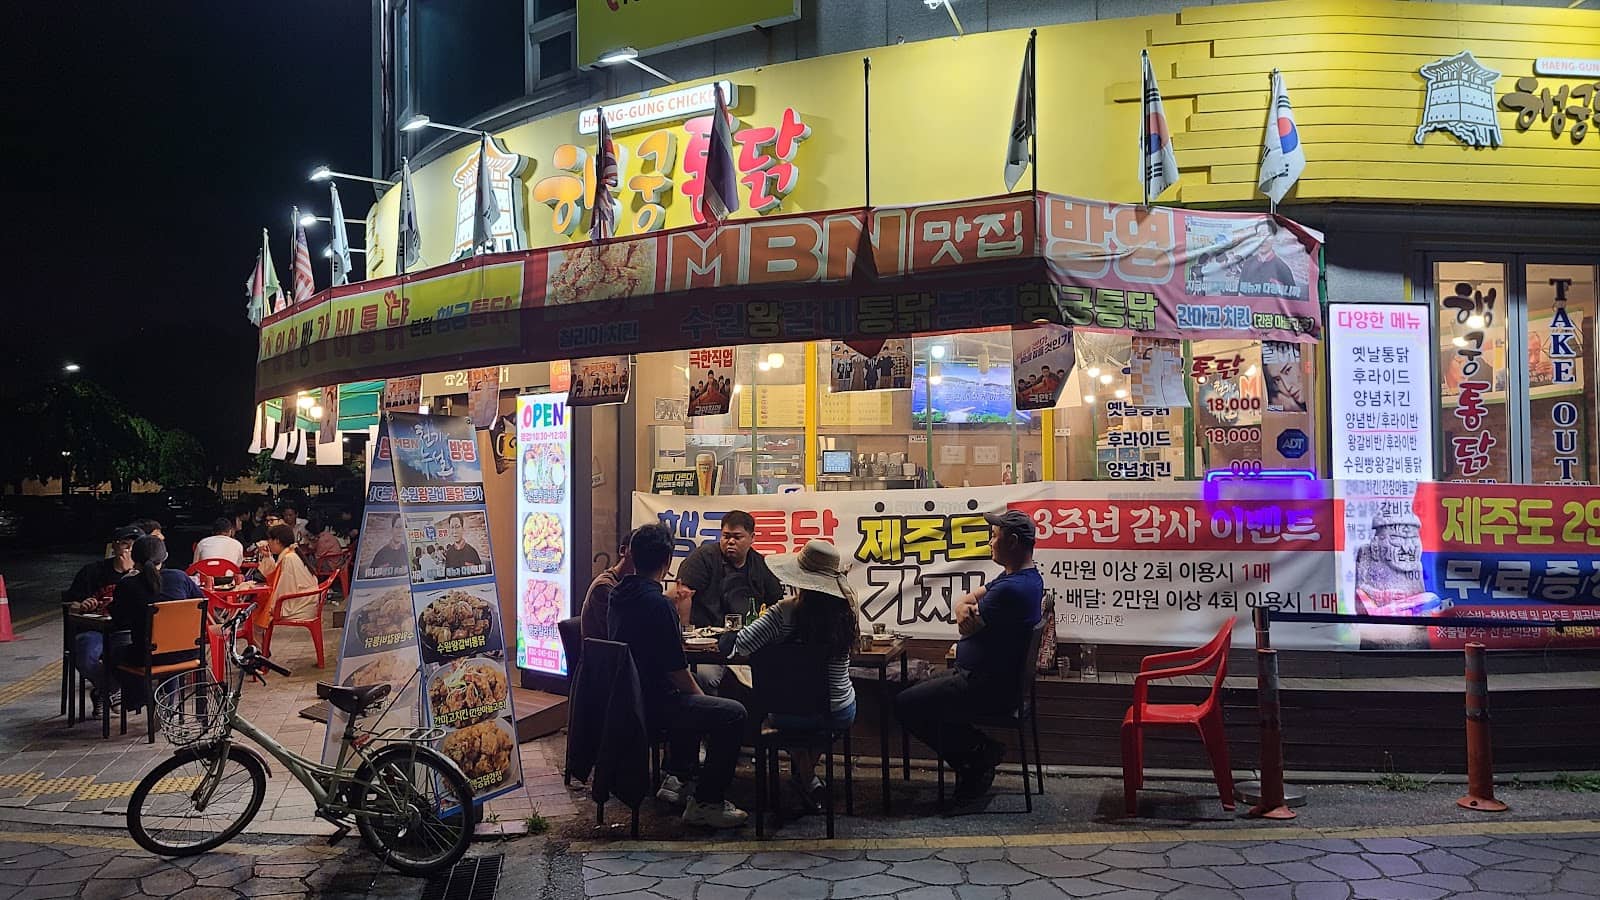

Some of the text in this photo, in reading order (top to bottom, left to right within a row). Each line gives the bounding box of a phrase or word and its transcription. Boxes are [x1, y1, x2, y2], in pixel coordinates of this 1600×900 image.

[583, 88, 727, 128] HANG-GUNG CHICKE
[1502, 77, 1600, 141] 행궁
[666, 194, 1175, 294] MBN 맛집 방영
[1222, 304, 1251, 330] 치킨
[1338, 311, 1421, 330] 다양한 메뉴
[1549, 278, 1576, 382] TAKE
[689, 349, 733, 369] 극한직업
[1352, 346, 1409, 364] 옛날통닭
[1352, 368, 1411, 386] 후라이드
[1443, 282, 1497, 476] 행궁통닭
[1206, 398, 1261, 412] 18,000
[1353, 390, 1411, 407] 양념치킨
[522, 401, 564, 429] OPEN
[1345, 412, 1419, 430] 양념반/후라이반
[1107, 428, 1260, 447] 후라이드 18,000
[1282, 438, 1305, 450] ADT
[1347, 434, 1418, 452] 왕갈비반/후라이반
[1552, 402, 1577, 480] OUT
[1107, 462, 1171, 478] 양념치킨
[1343, 456, 1422, 474] 수원빵왕갈비통닭
[1130, 506, 1201, 543] 감사
[1210, 506, 1321, 543] 이벤트
[1441, 496, 1555, 545] 제주도
[1050, 560, 1096, 581] 4만원
[1102, 560, 1138, 582] 이상
[1143, 561, 1173, 582] 2회
[1179, 560, 1234, 582] 이용시
[1242, 563, 1271, 584] 1매
[1112, 589, 1160, 611] 2만원
[1166, 589, 1202, 611] 이상
[1207, 590, 1239, 612] 4회
[1245, 590, 1301, 613] 이용시
[1309, 592, 1338, 612] 1매
[437, 635, 486, 654] 수원왕갈비통닭
